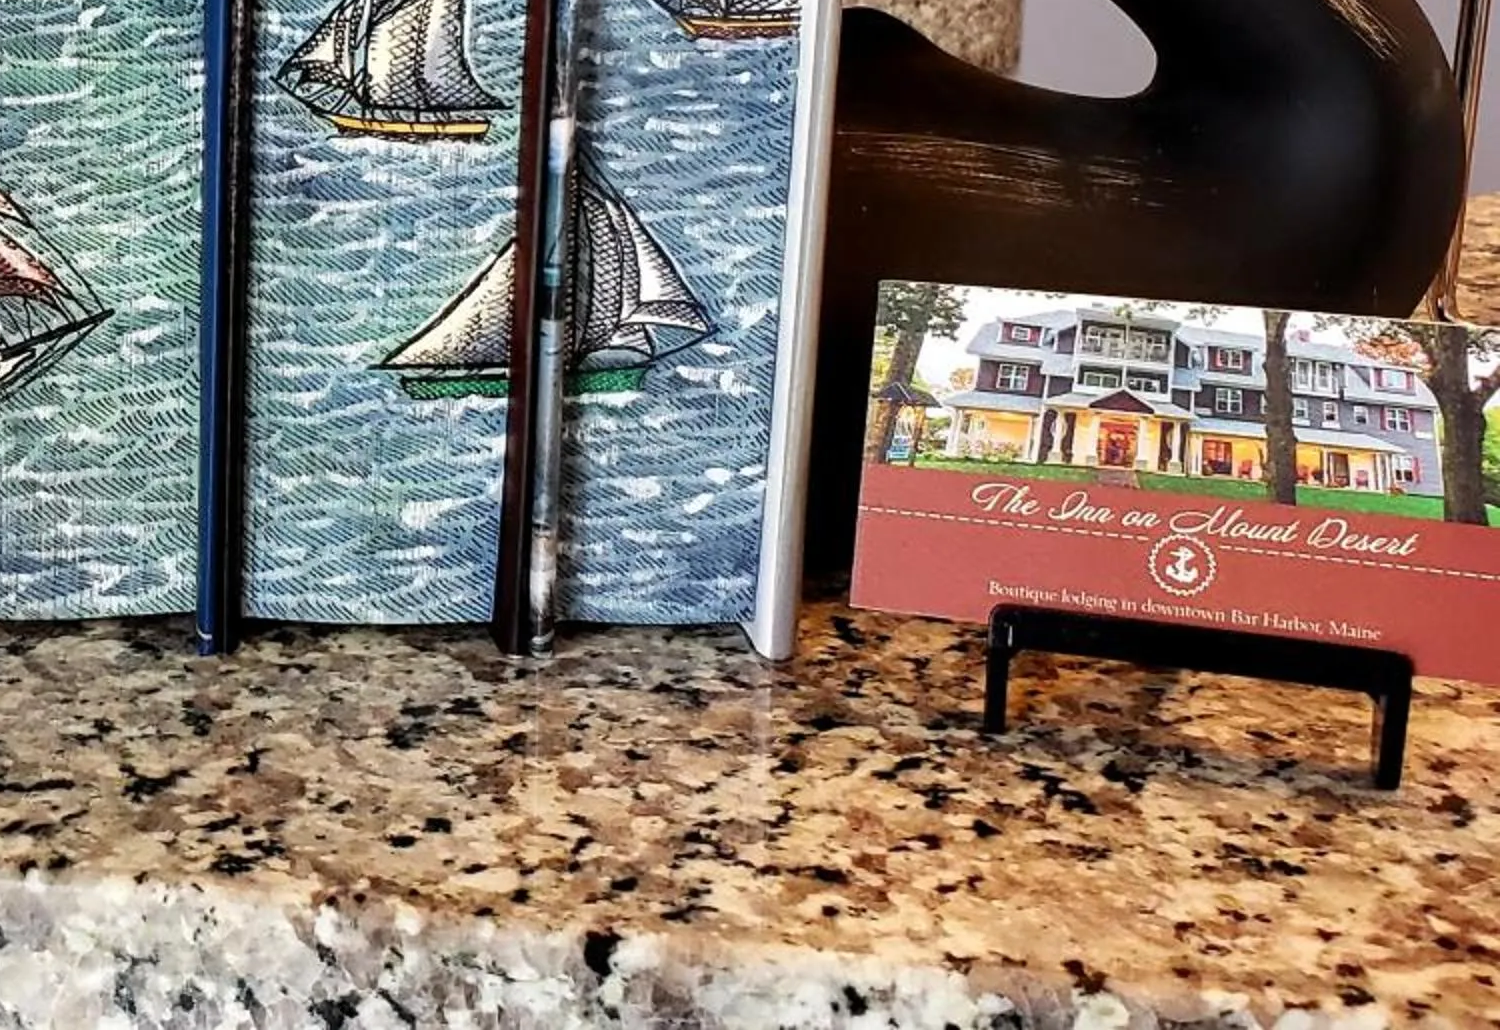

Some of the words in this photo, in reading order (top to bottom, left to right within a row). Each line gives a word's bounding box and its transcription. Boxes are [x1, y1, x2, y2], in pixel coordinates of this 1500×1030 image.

[972, 483, 1041, 515] The
[1048, 491, 1115, 523] Inn
[1121, 510, 1161, 527] on
[1169, 506, 1300, 543] Mount
[1307, 518, 1419, 556] Desert
[988, 580, 1060, 604] Boutique
[1061, 587, 1116, 613] lodging
[1121, 598, 1137, 612] in
[1141, 597, 1225, 623] downtown
[1231, 608, 1260, 626] Bar
[1263, 612, 1323, 635] Harbor,
[1328, 620, 1382, 641] Maine
